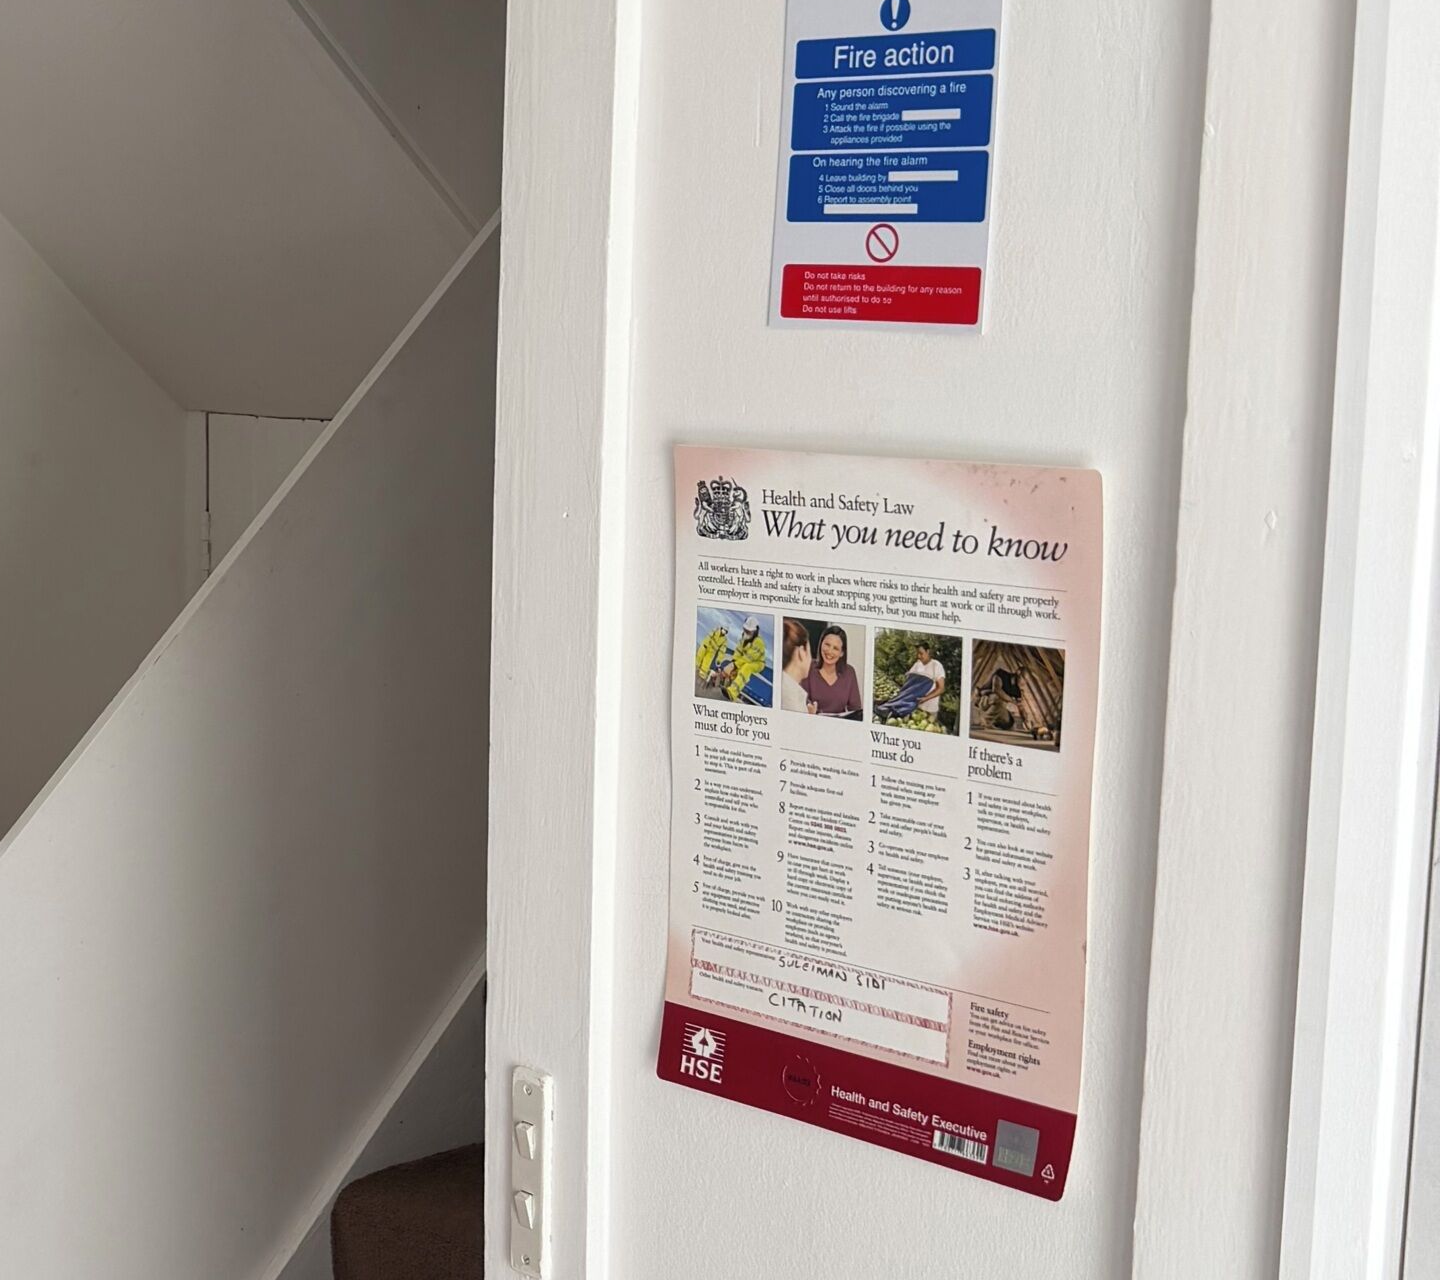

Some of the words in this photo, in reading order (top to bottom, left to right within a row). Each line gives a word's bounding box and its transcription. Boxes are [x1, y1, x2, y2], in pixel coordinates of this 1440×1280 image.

[834, 44, 876, 69] Fire
[883, 40, 953, 67] action
[816, 87, 837, 100] Any
[839, 87, 875, 100] person
[877, 83, 936, 97] discovering
[939, 83, 946, 93] a
[949, 81, 966, 93] fire
[830, 102, 854, 111] Sound
[854, 102, 866, 110] the
[867, 101, 888, 110] alarm
[829, 112, 844, 122] Call
[845, 113, 857, 122] the
[858, 112, 871, 121] fire
[871, 112, 902, 122] brigade
[828, 124, 851, 133] Attack
[852, 124, 865, 132] the
[866, 123, 878, 132] fire
[885, 122, 916, 133] possible
[917, 122, 937, 132] using
[938, 121, 951, 130] the
[830, 135, 869, 145] appliances
[870, 133, 903, 144] provided
[812, 156, 826, 167] On
[828, 156, 863, 169] hearing
[865, 156, 881, 166] the
[883, 155, 898, 166] fire
[900, 155, 927, 165] alarm
[825, 173, 847, 182] Leave
[847, 173, 876, 183] building
[877, 172, 888, 183] by
[824, 183, 845, 193] Close
[846, 184, 855, 192] all
[855, 184, 877, 192] doors
[878, 183, 903, 192] behind
[904, 184, 918, 193] you
[822, 194, 848, 205] Report
[848, 195, 857, 204] to
[856, 194, 892, 205] assembly
[891, 195, 913, 205] point
[804, 270, 815, 279] Do
[830, 272, 846, 280] take
[848, 272, 865, 280] risks
[803, 281, 815, 290] Do
[829, 283, 852, 291] return
[862, 283, 875, 292] the
[875, 283, 906, 294] building
[907, 284, 918, 293] for
[919, 286, 934, 295] any
[935, 286, 962, 294] reason
[802, 293, 819, 301] until
[820, 294, 860, 303] authorised
[861, 295, 869, 303] to
[870, 295, 880, 303] do
[801, 303, 813, 312] Do
[814, 305, 826, 313] not
[843, 305, 857, 314] lifts
[761, 488, 806, 508] Health
[809, 492, 834, 509] and
[838, 494, 879, 516] Safety
[882, 497, 914, 515] Law
[761, 509, 826, 541] What
[831, 514, 877, 550] you
[885, 521, 944, 551] need
[952, 529, 978, 554] to
[987, 525, 1068, 562] know
[697, 561, 709, 570] All
[710, 563, 739, 574] workers
[740, 565, 757, 576] have
[765, 567, 783, 579] right
[795, 571, 815, 582] work
[827, 573, 851, 585] places
[852, 576, 877, 588] where
[879, 579, 898, 590] risks
[910, 581, 930, 593] their
[932, 583, 958, 596] health
[960, 587, 977, 598] and
[978, 589, 1004, 601] safety
[1006, 594, 1020, 602] are
[1022, 595, 1059, 606] properly
[697, 575, 735, 585] controlled.
[736, 577, 762, 588] Health
[763, 581, 778, 590] and
[779, 582, 802, 594] safety
[811, 585, 834, 596] about
[835, 589, 870, 601] stopping
[871, 593, 887, 602] you
[888, 595, 918, 607] getting
[919, 596, 937, 607] hurt
[950, 601, 972, 610] work
[986, 603, 995, 613] ill
[997, 604, 1032, 618] through
[1034, 610, 1061, 620] work.
[698, 584, 715, 594] Your
[716, 587, 750, 600] employer
[759, 593, 800, 604] responsible
[801, 595, 813, 605] for
[814, 597, 839, 608] health
[840, 601, 856, 610] and
[858, 602, 883, 615] safety,
[885, 604, 899, 615] but
[901, 608, 917, 618] you
[918, 610, 939, 619] must
[941, 610, 961, 624] help.
[692, 703, 718, 718] What
[719, 709, 769, 727] employers
[694, 720, 717, 732] must
[719, 721, 733, 734] do
[734, 722, 751, 736] for
[751, 728, 771, 742] you
[869, 729, 899, 746] What
[901, 738, 922, 753] you
[695, 744, 700, 757] 1
[871, 749, 897, 761] must
[899, 749, 914, 763] do
[968, 745, 978, 759] If
[979, 747, 1013, 765] there's
[1015, 757, 1022, 767] a
[779, 759, 787, 771] 6
[967, 764, 1011, 781] problem
[694, 778, 701, 791] 2
[779, 779, 787, 792] 7
[871, 774, 876, 787] 1
[967, 791, 972, 805] 1
[778, 801, 786, 814] 8
[694, 812, 701, 825] 3
[868, 810, 876, 824] 2
[867, 840, 875, 853] 3
[964, 836, 972, 850] 2
[693, 853, 700, 866] 4
[776, 850, 785, 863] 9
[866, 862, 874, 875] 4
[962, 866, 971, 880] 3
[692, 881, 700, 893] 5
[771, 899, 783, 913] 10
[768, 992, 843, 1023] CITATION
[970, 1001, 985, 1013] Fire
[986, 1007, 1009, 1020] safety
[968, 1039, 1017, 1059] Employment
[1018, 1052, 1041, 1066] rights
[679, 1054, 723, 1084] HSE
[831, 1085, 866, 1106] Health
[868, 1097, 890, 1113] and
[892, 1103, 929, 1126] Safety
[931, 1114, 988, 1141] Executive
